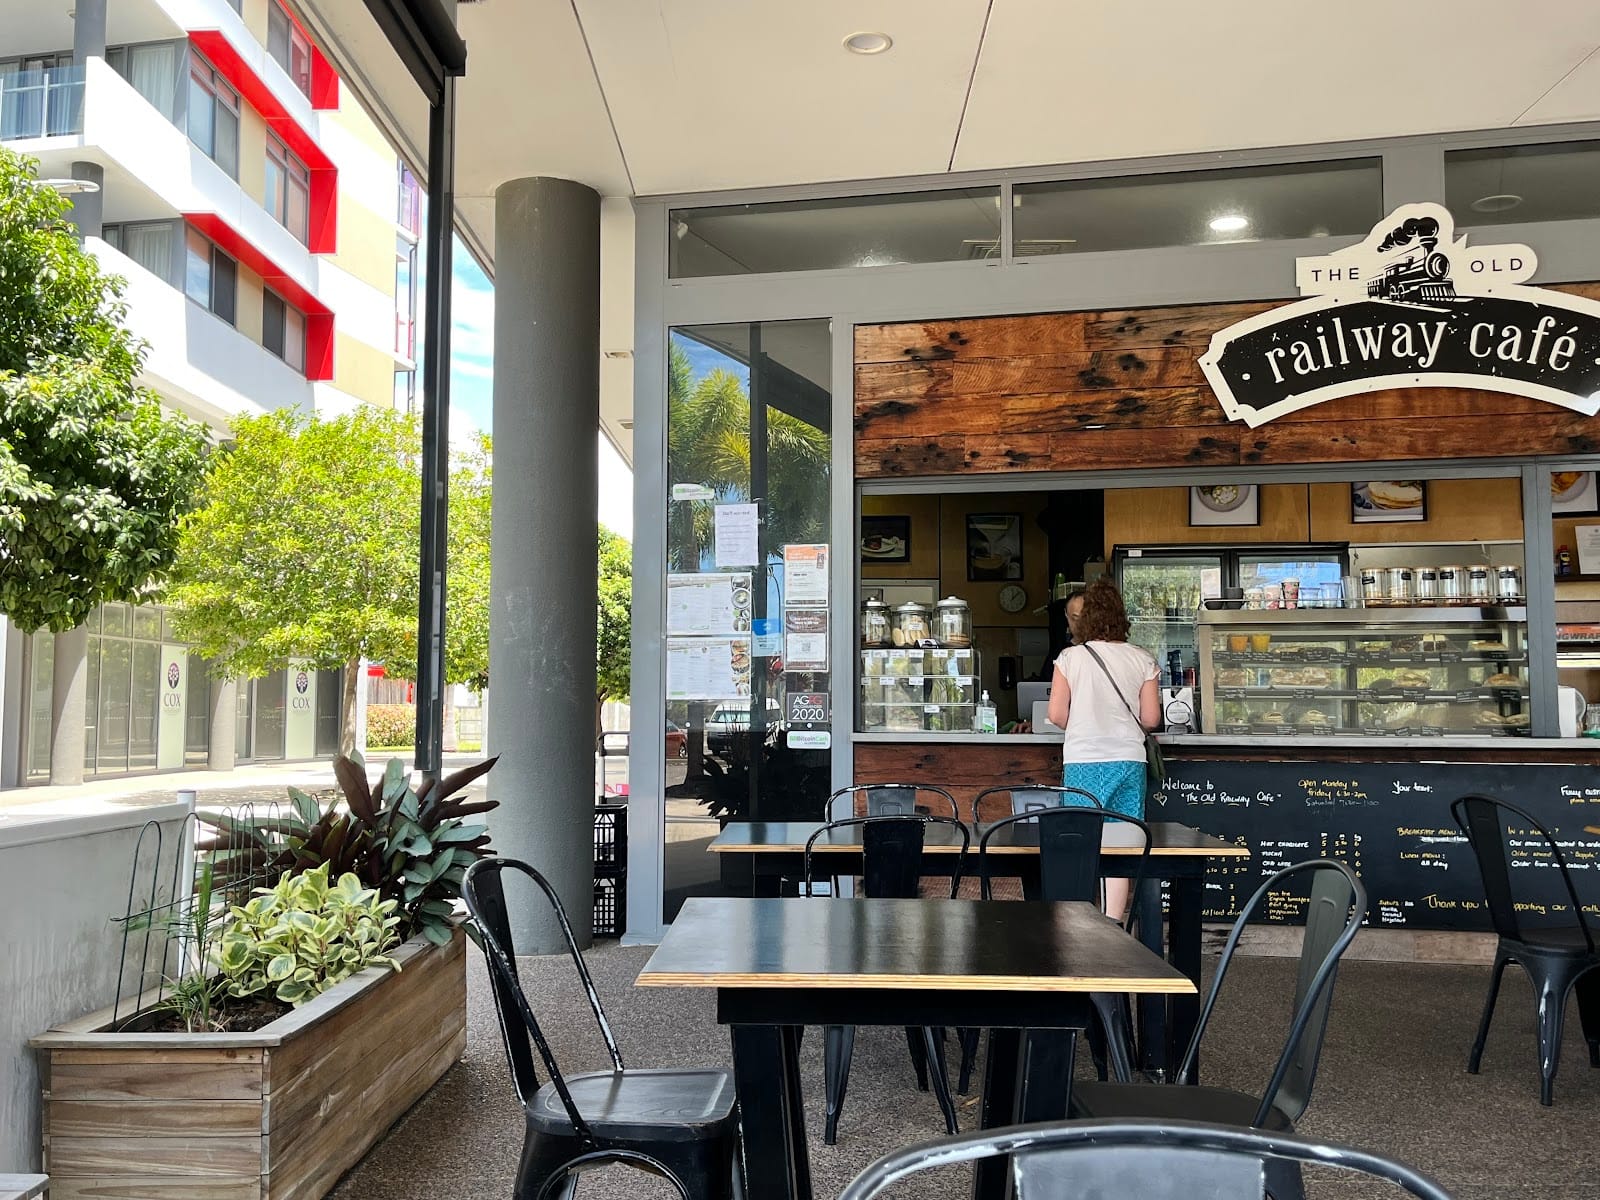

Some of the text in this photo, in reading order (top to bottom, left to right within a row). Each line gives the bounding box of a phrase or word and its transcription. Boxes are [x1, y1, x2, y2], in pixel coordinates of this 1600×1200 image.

[1311, 257, 1523, 282] THE OLD
[1264, 314, 1578, 384] railway café
[164, 693, 181, 707] COX
[292, 697, 310, 709] COX
[792, 709, 824, 720] 2020
[1162, 778, 1214, 790] Welcome to
[1392, 780, 1411, 794] Your
[1200, 792, 1216, 802] Old
[1420, 894, 1457, 908] Thank
[1462, 901, 1479, 911] you
[1513, 902, 1546, 914] pporting
